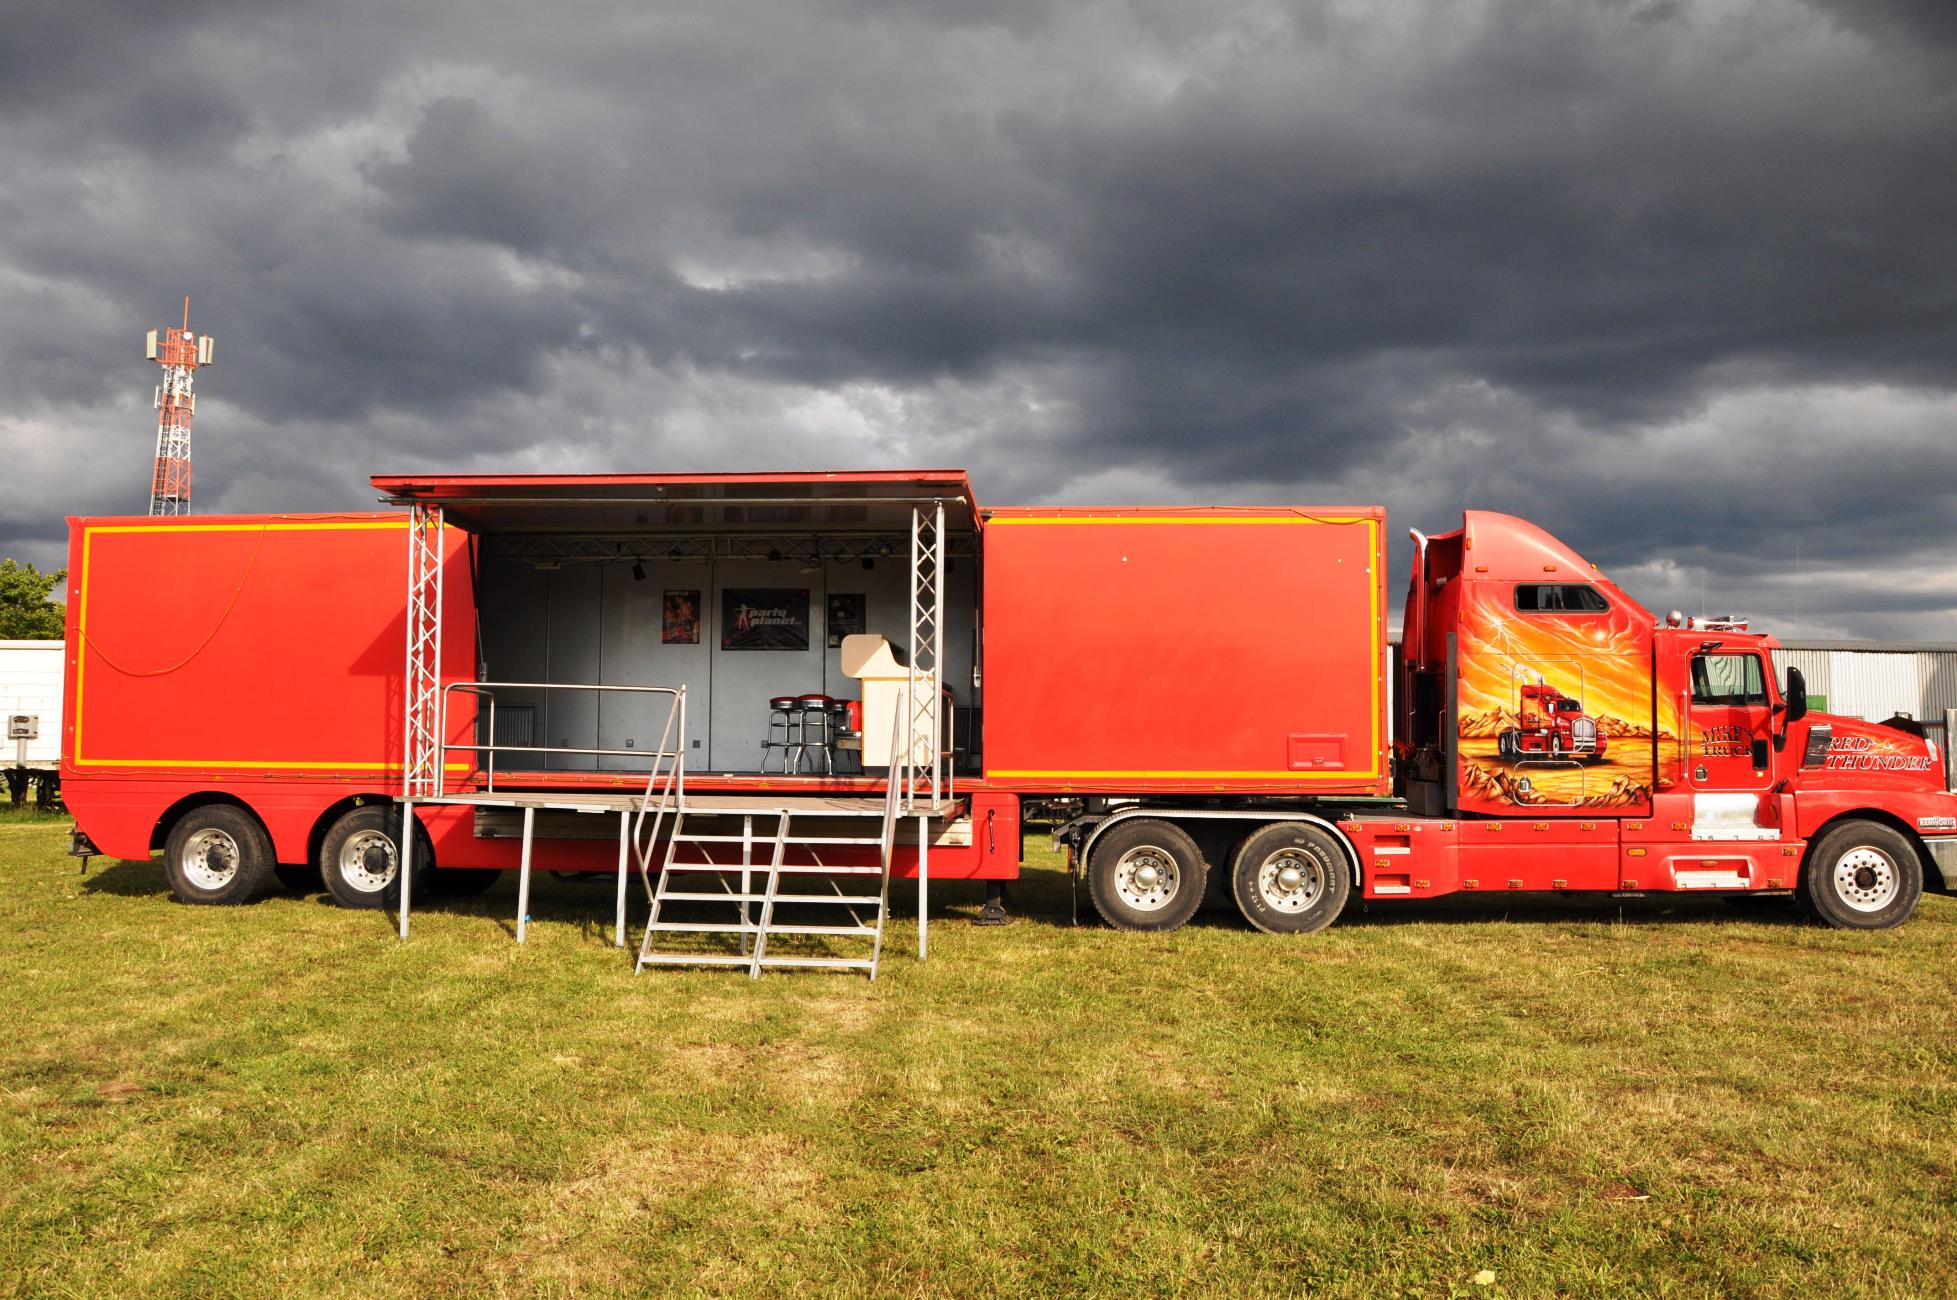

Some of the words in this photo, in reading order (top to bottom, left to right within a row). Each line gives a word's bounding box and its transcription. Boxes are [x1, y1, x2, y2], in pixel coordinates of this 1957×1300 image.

[748, 607, 788, 618] party
[1826, 736, 1870, 752] RED
[1826, 754, 1931, 771] THUNDER
